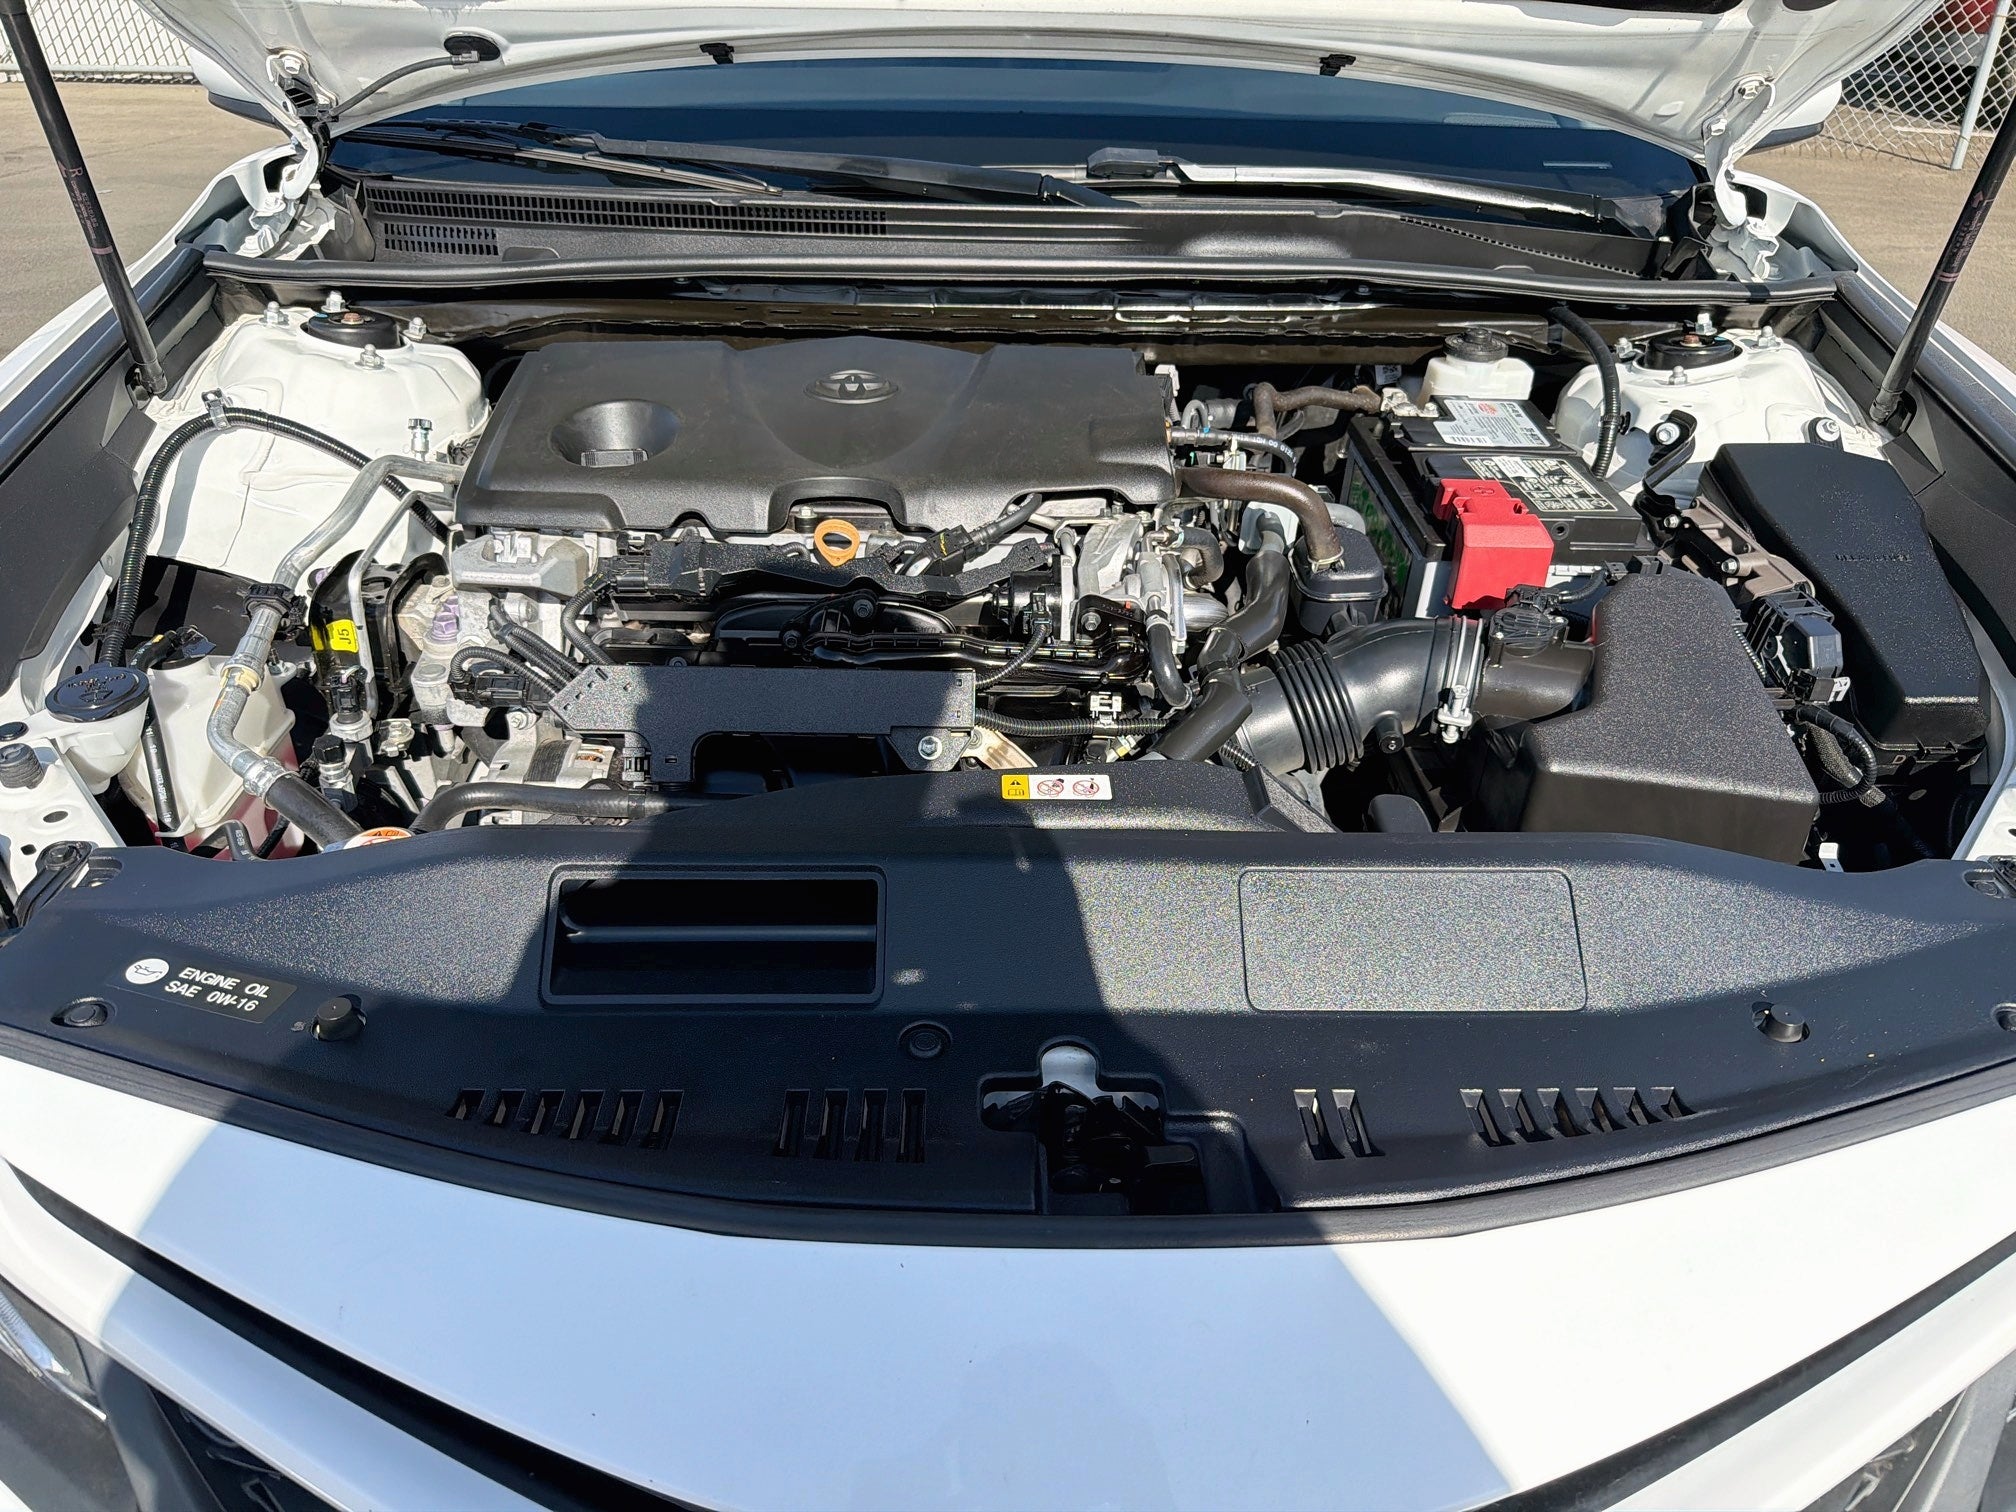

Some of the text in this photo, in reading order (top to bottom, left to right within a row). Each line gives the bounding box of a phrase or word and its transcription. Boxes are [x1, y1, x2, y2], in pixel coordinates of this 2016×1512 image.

[337, 628, 351, 644] J5
[164, 981, 259, 1012] SAE 0W-16
[178, 966, 271, 999] ENGINE OIL
